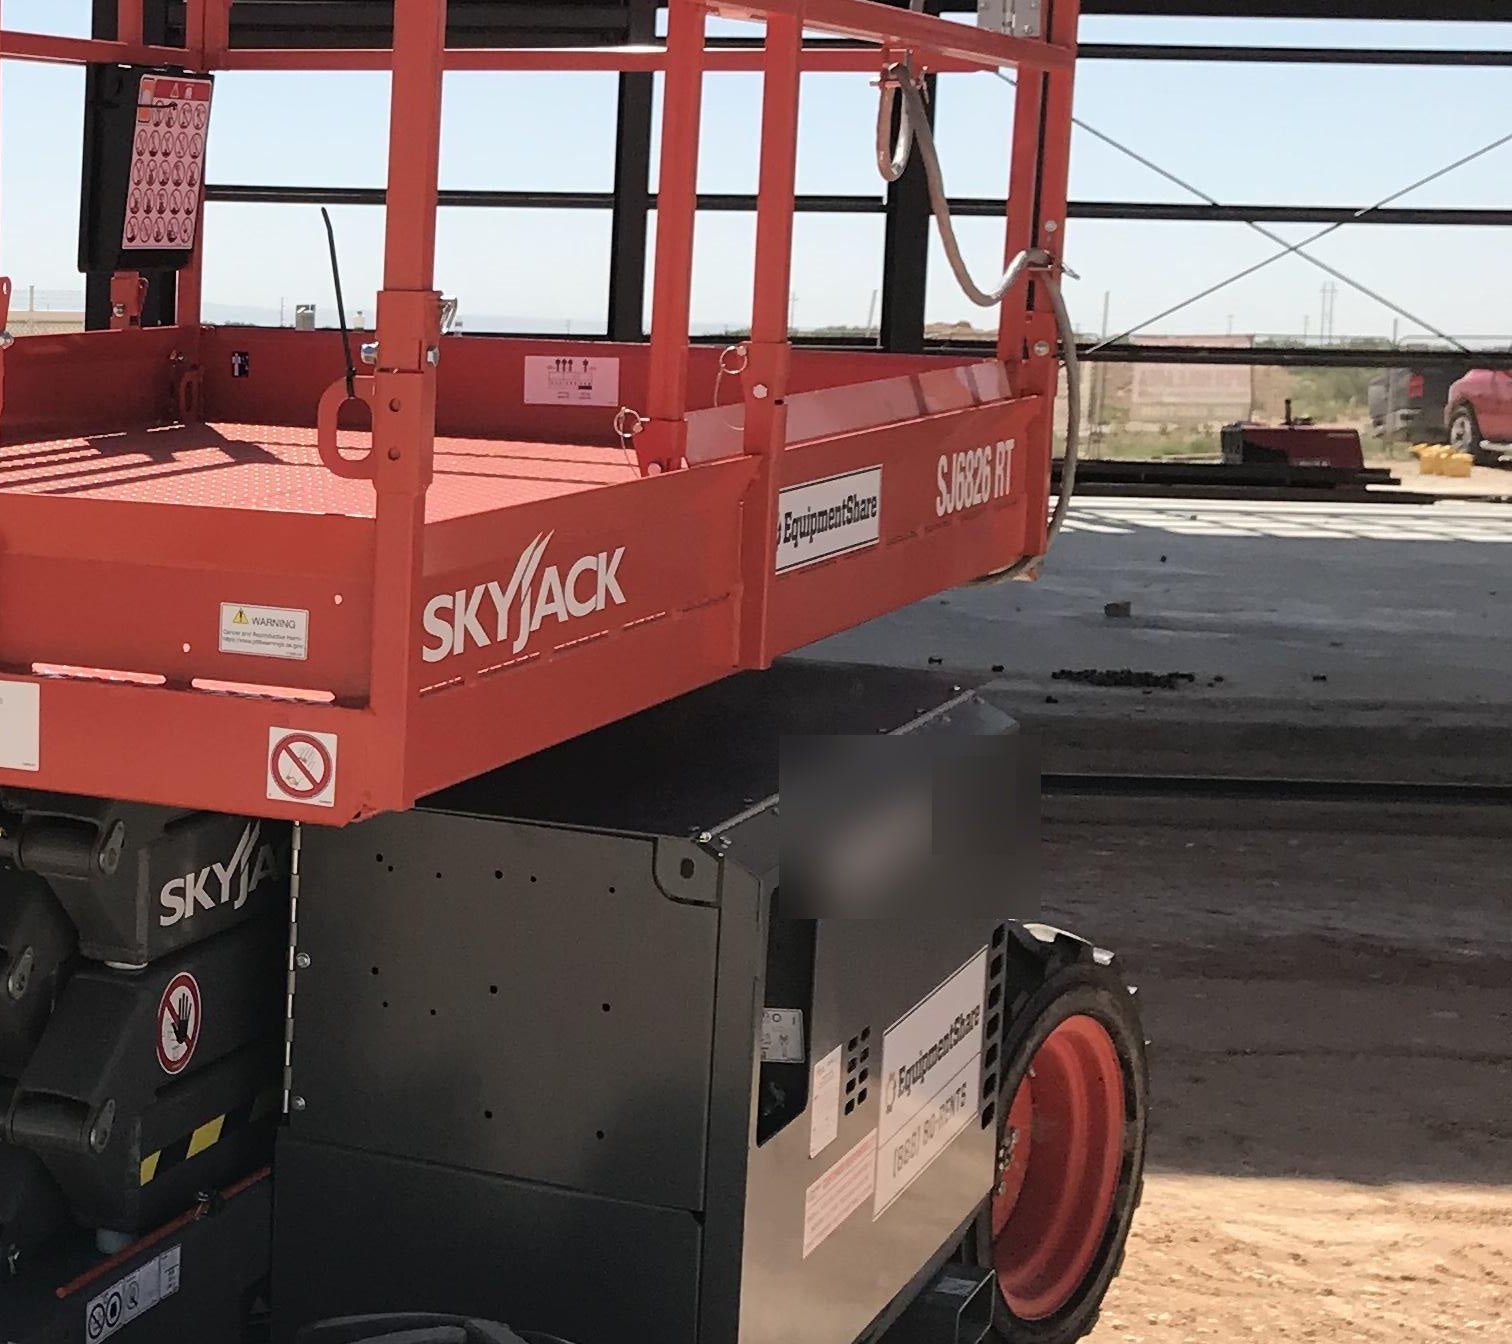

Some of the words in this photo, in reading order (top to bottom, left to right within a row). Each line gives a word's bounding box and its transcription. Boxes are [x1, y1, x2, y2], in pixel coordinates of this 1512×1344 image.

[783, 493, 877, 547] EquipmentShare
[936, 445, 991, 516] SJ6826
[994, 439, 1015, 498] RT
[251, 617, 296, 629] WARNING
[422, 530, 626, 662] SKYJACK
[159, 819, 281, 927] SKYJA
[898, 1004, 980, 1098] EquipmentShare
